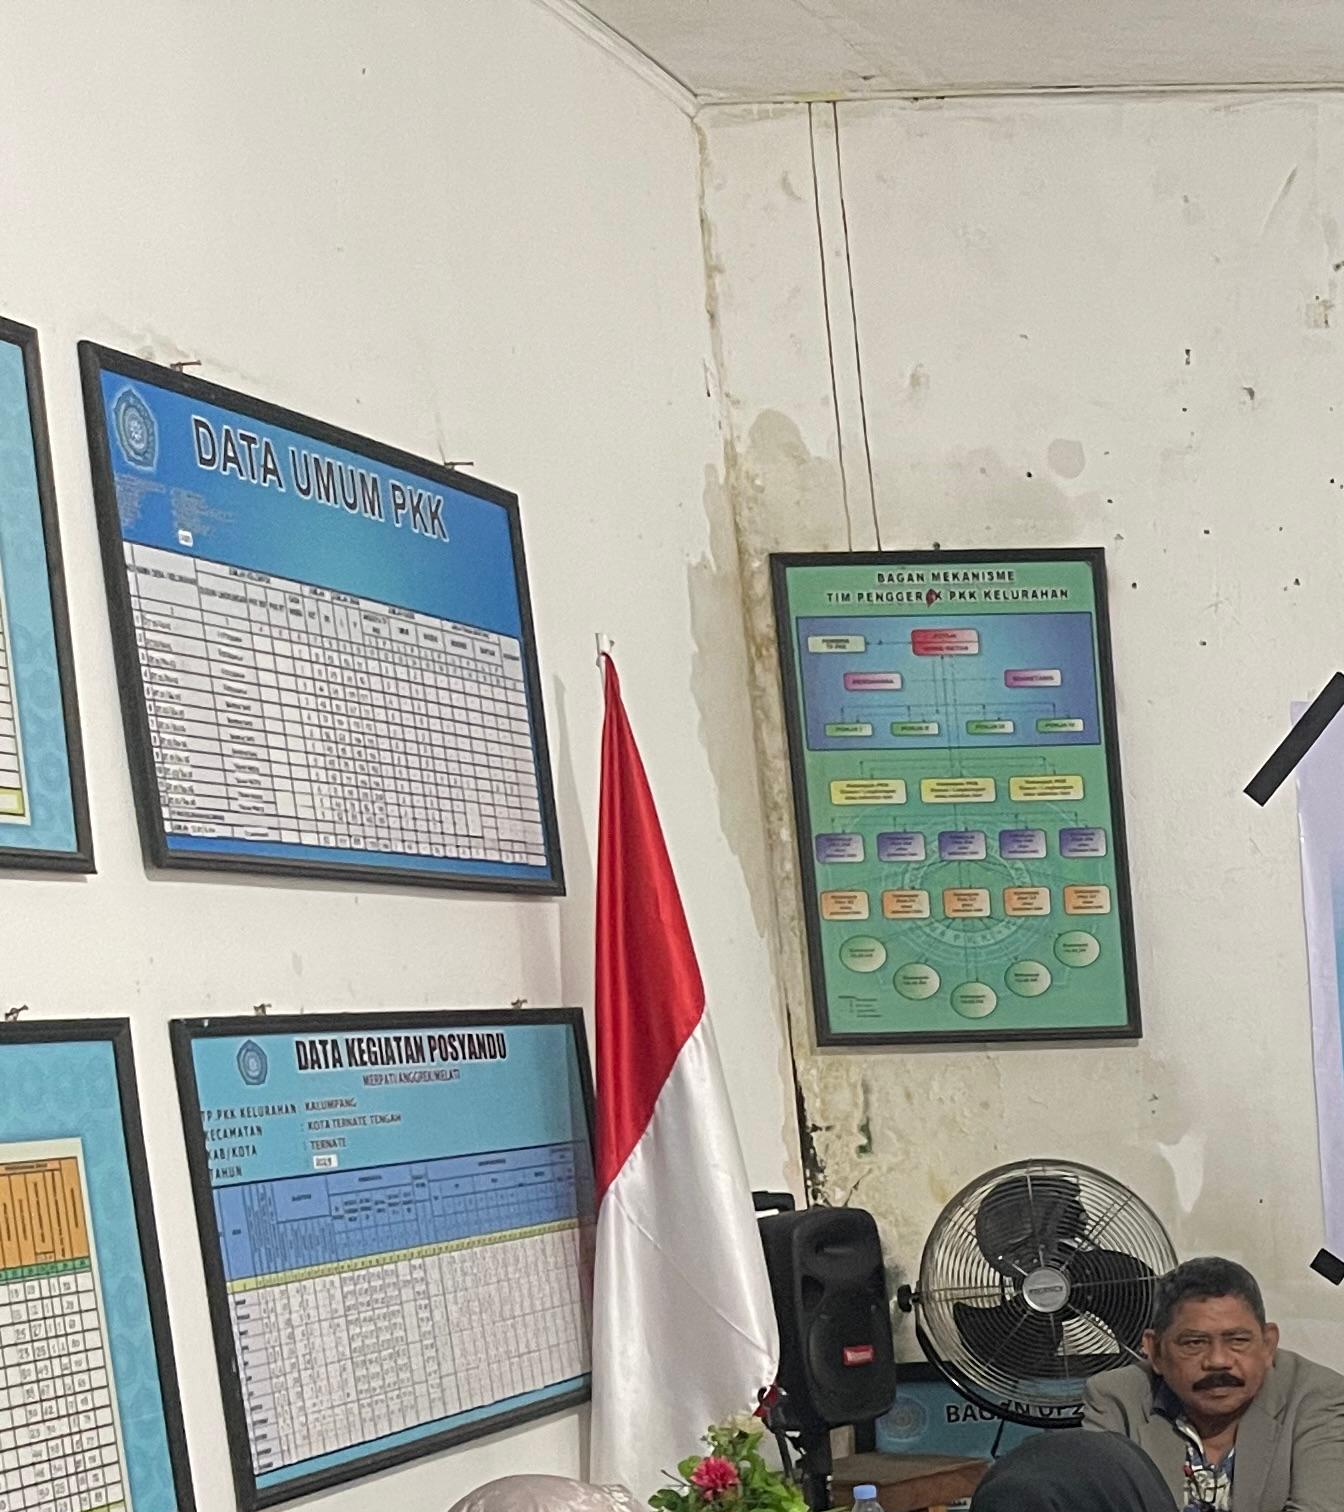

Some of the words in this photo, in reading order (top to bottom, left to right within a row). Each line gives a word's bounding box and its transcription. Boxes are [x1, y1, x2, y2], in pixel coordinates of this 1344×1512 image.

[192, 416, 285, 491] DATA
[290, 447, 384, 522] UMUM
[389, 480, 449, 542] PKK
[877, 571, 925, 584] BAGAN
[931, 570, 1015, 583] MEKANISME
[826, 592, 850, 603] TIM
[857, 590, 942, 603] PENGGERK
[949, 590, 977, 602] PKK
[983, 589, 1068, 601] KELURAHAN
[295, 1036, 344, 1070] DATA
[345, 1034, 426, 1067] KEGIATAN
[429, 1032, 508, 1062] POSYANDU
[240, 1103, 296, 1119] KELURAHAN
[308, 1119, 330, 1131] KOTA
[331, 1116, 367, 1129] TERNATE
[369, 1113, 401, 1126] TENGAH
[311, 1137, 346, 1150] TERNATE
